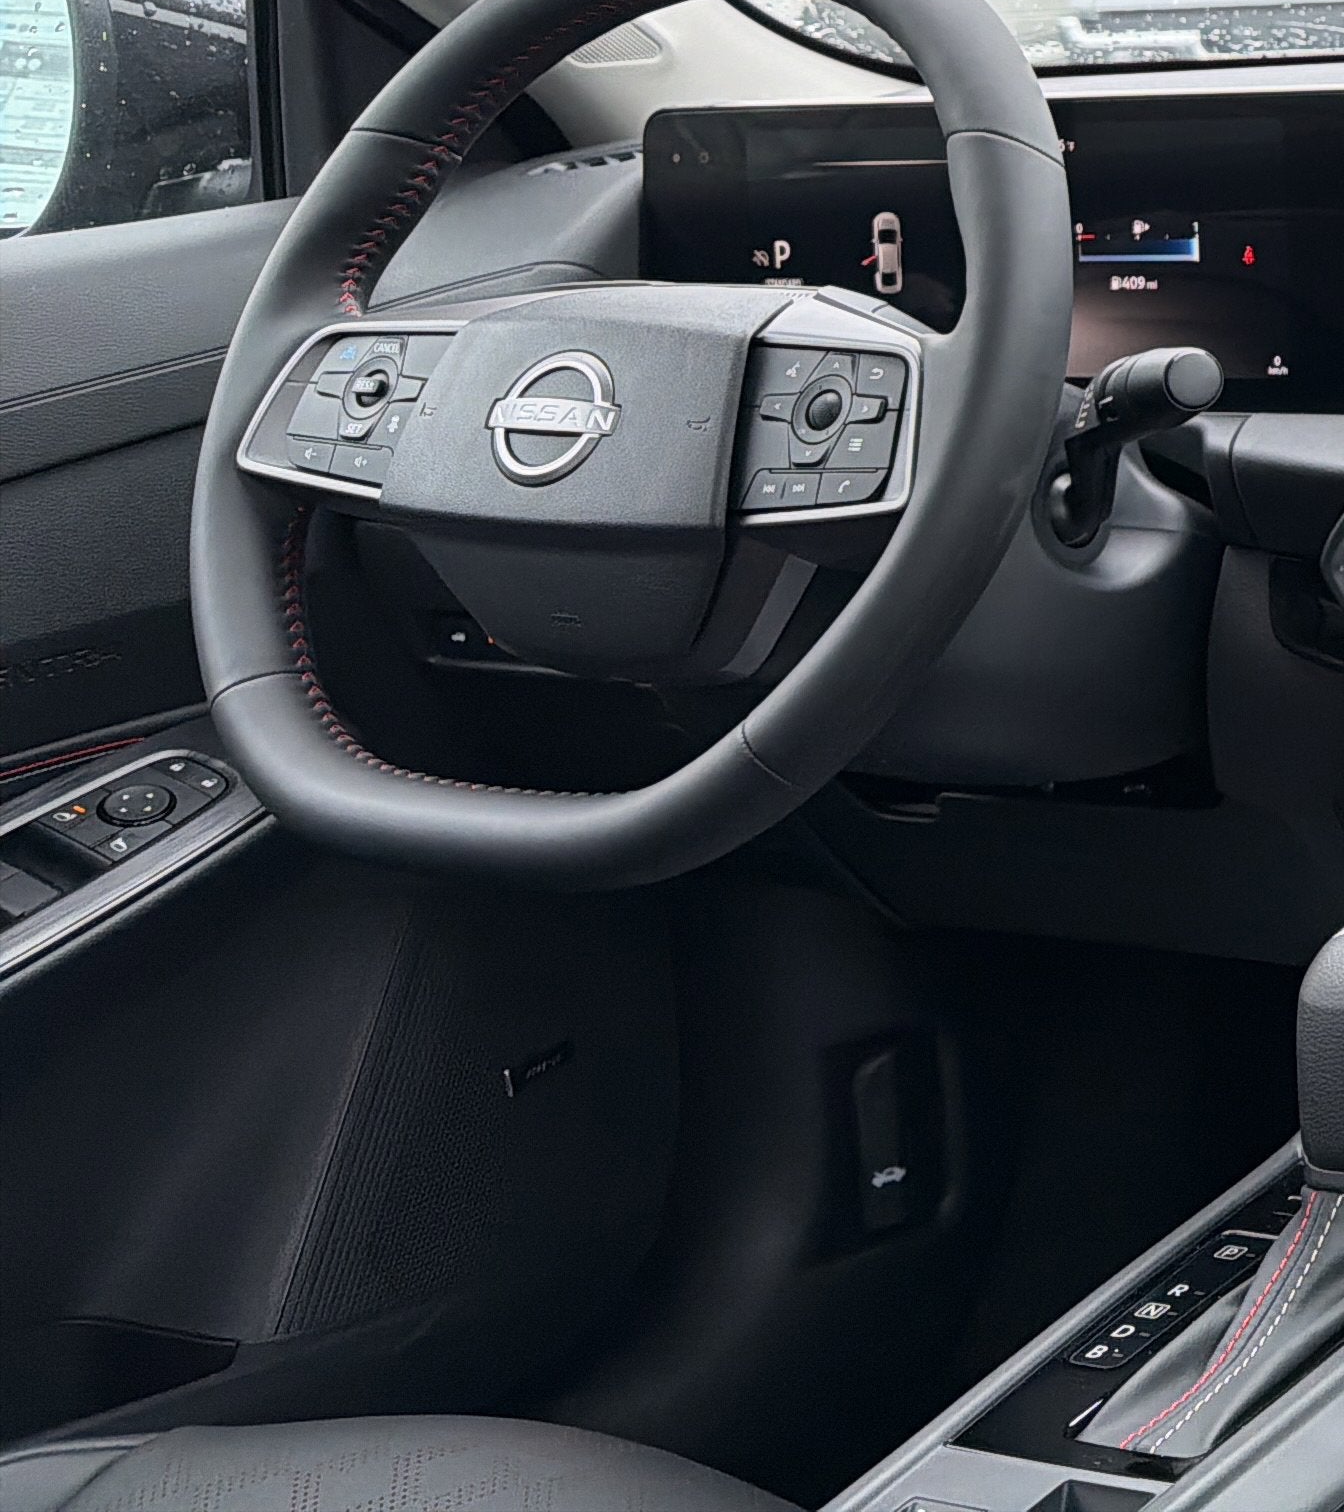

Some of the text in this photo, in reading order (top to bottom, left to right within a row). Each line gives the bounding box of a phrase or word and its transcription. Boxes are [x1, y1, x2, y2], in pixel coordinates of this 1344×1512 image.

[774, 240, 791, 270] P
[1123, 276, 1158, 290] 409 mi
[373, 341, 400, 354] CANCEL
[489, 402, 616, 433] NISSAN
[345, 423, 363, 435] SET
[1167, 1284, 1189, 1297] R
[1110, 1325, 1135, 1338] D
[1085, 1345, 1109, 1359] B
